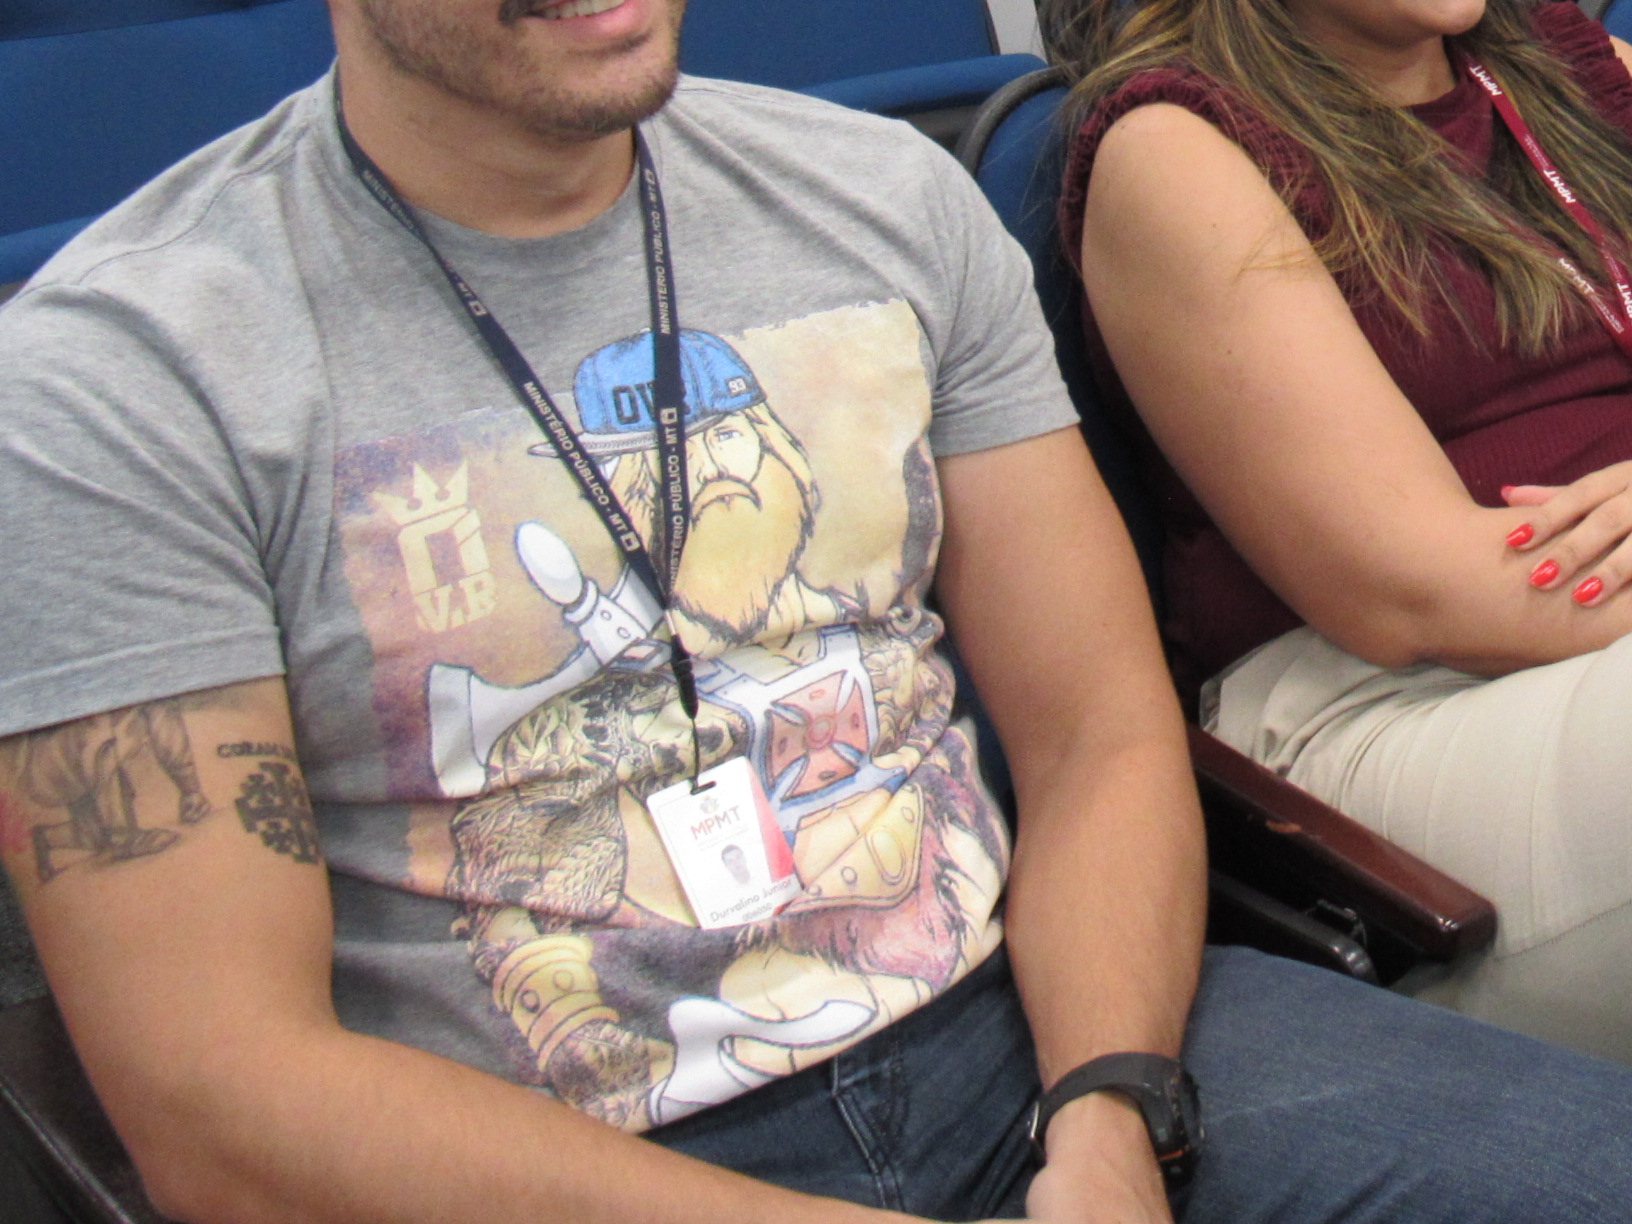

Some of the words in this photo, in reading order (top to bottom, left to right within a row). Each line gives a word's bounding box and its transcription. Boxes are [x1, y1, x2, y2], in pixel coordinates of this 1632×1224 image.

[1469, 65, 1502, 96] MPMT
[1543, 169, 1576, 203] MPMT
[655, 265, 671, 335] MINISTÉRIO
[729, 378, 746, 393] 93
[665, 426, 678, 445] MT
[523, 381, 574, 451] MINISTÉRIO
[569, 452, 610, 506] PÚBLICO
[608, 513, 628, 532] MT
[667, 455, 683, 513] PÚBLICO
[690, 805, 741, 840] MPMT
[710, 892, 761, 923] Durvalino
